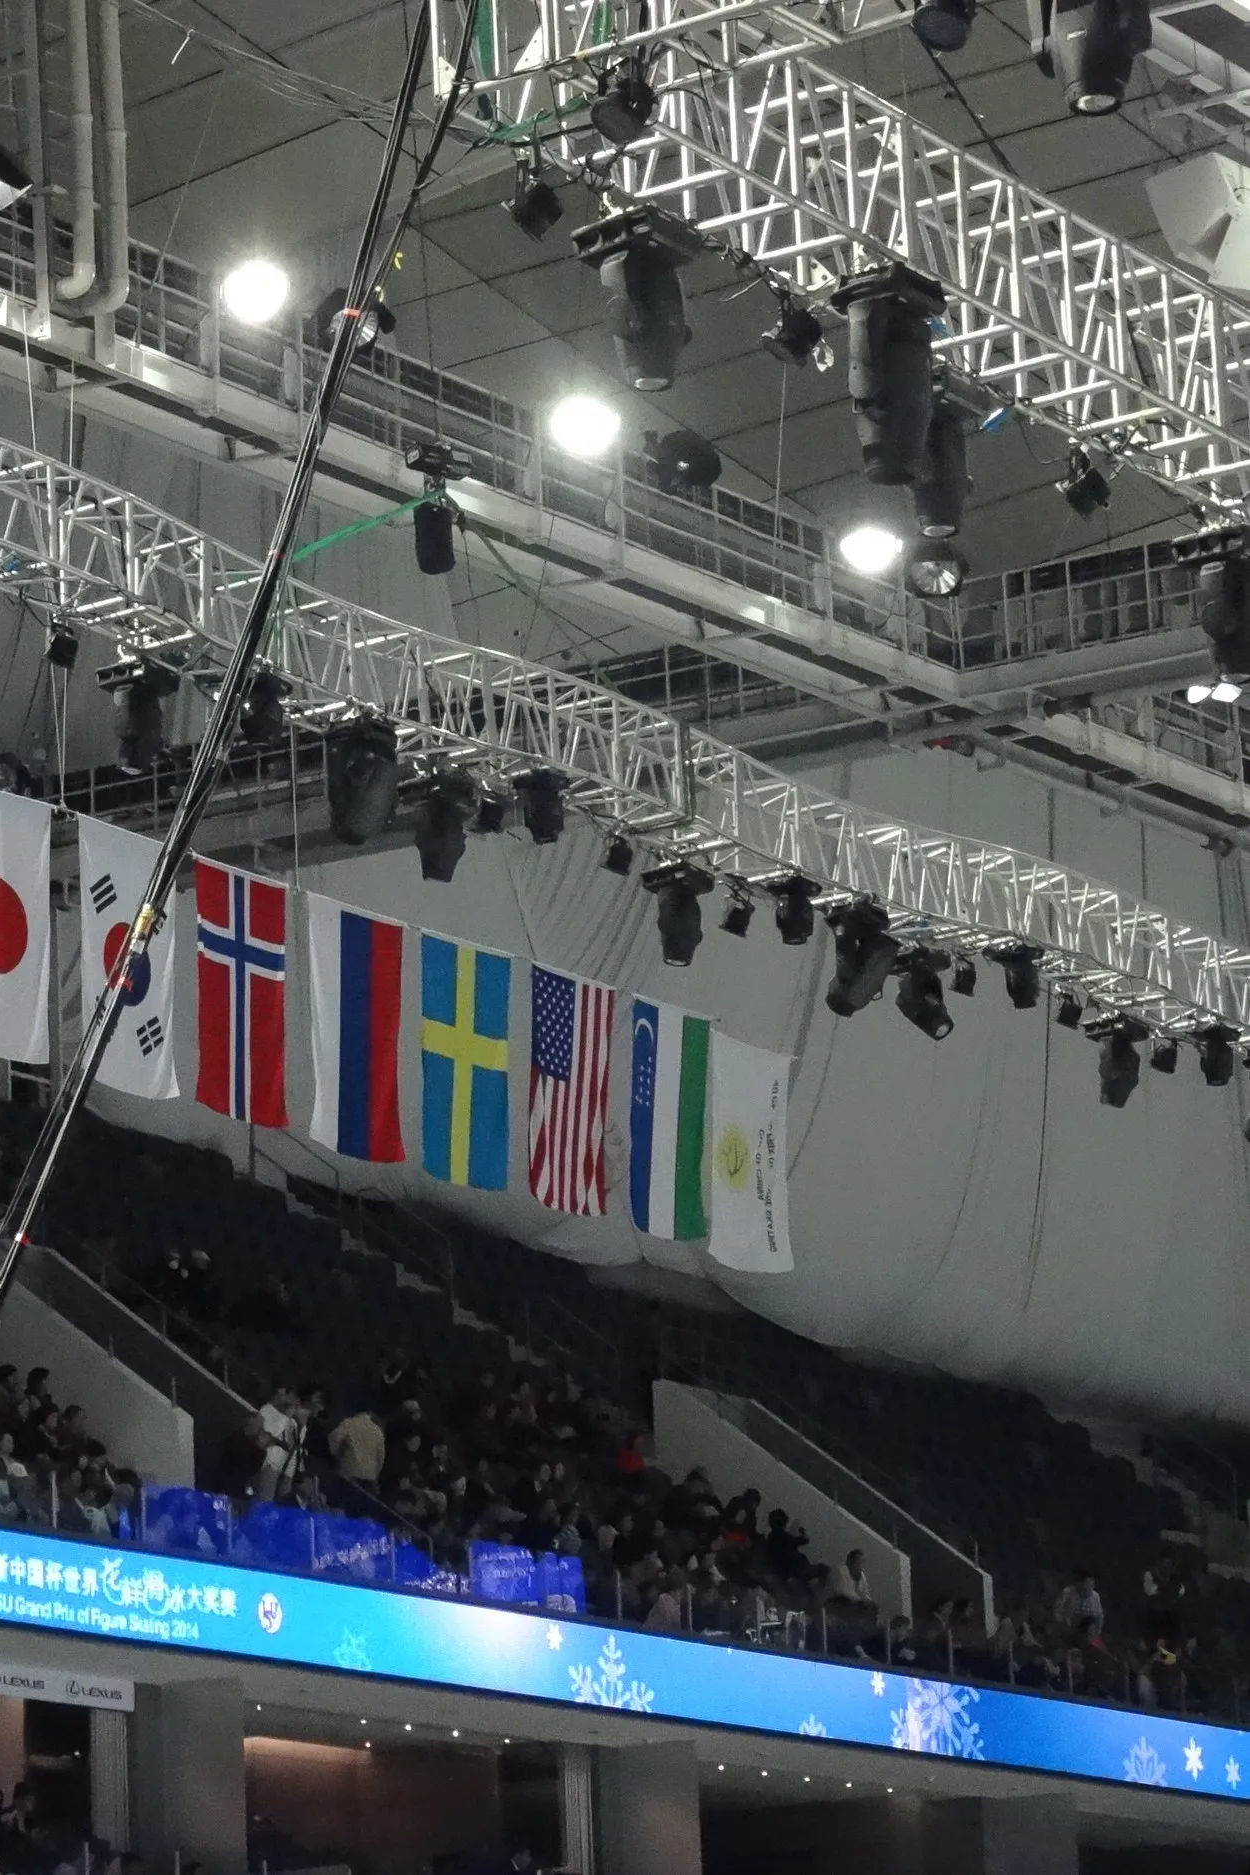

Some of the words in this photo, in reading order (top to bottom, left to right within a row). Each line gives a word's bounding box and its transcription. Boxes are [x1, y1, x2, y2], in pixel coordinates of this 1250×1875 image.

[15, 1595, 52, 1619] Grand
[91, 1607, 127, 1631] Figure
[172, 1619, 200, 1639] 2014
[2, 1675, 46, 1690] LEXUS
[81, 1686, 123, 1701] LEXUS
